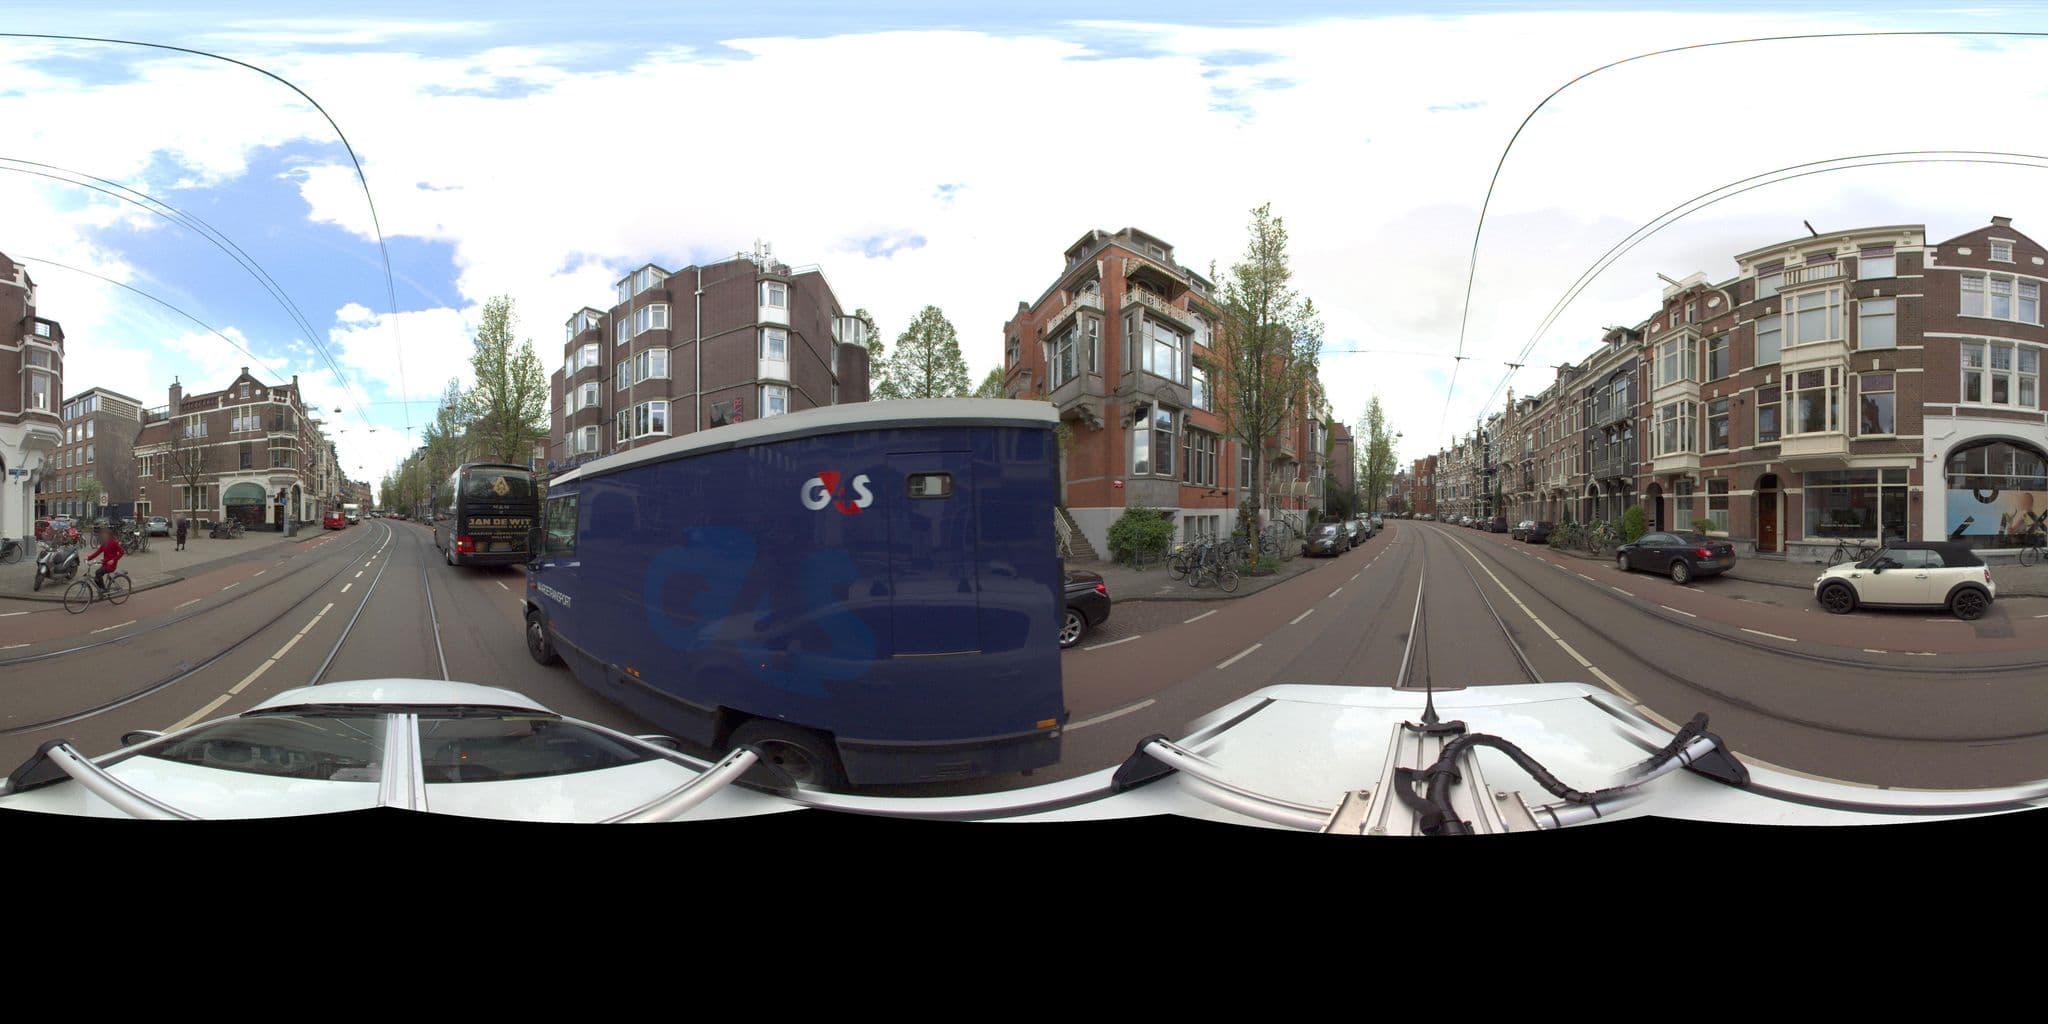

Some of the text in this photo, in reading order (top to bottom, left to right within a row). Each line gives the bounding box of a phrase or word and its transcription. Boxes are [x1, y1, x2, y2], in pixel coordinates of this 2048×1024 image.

[801, 471, 874, 514] G4S
[468, 518, 532, 526] JAN DE WIT
